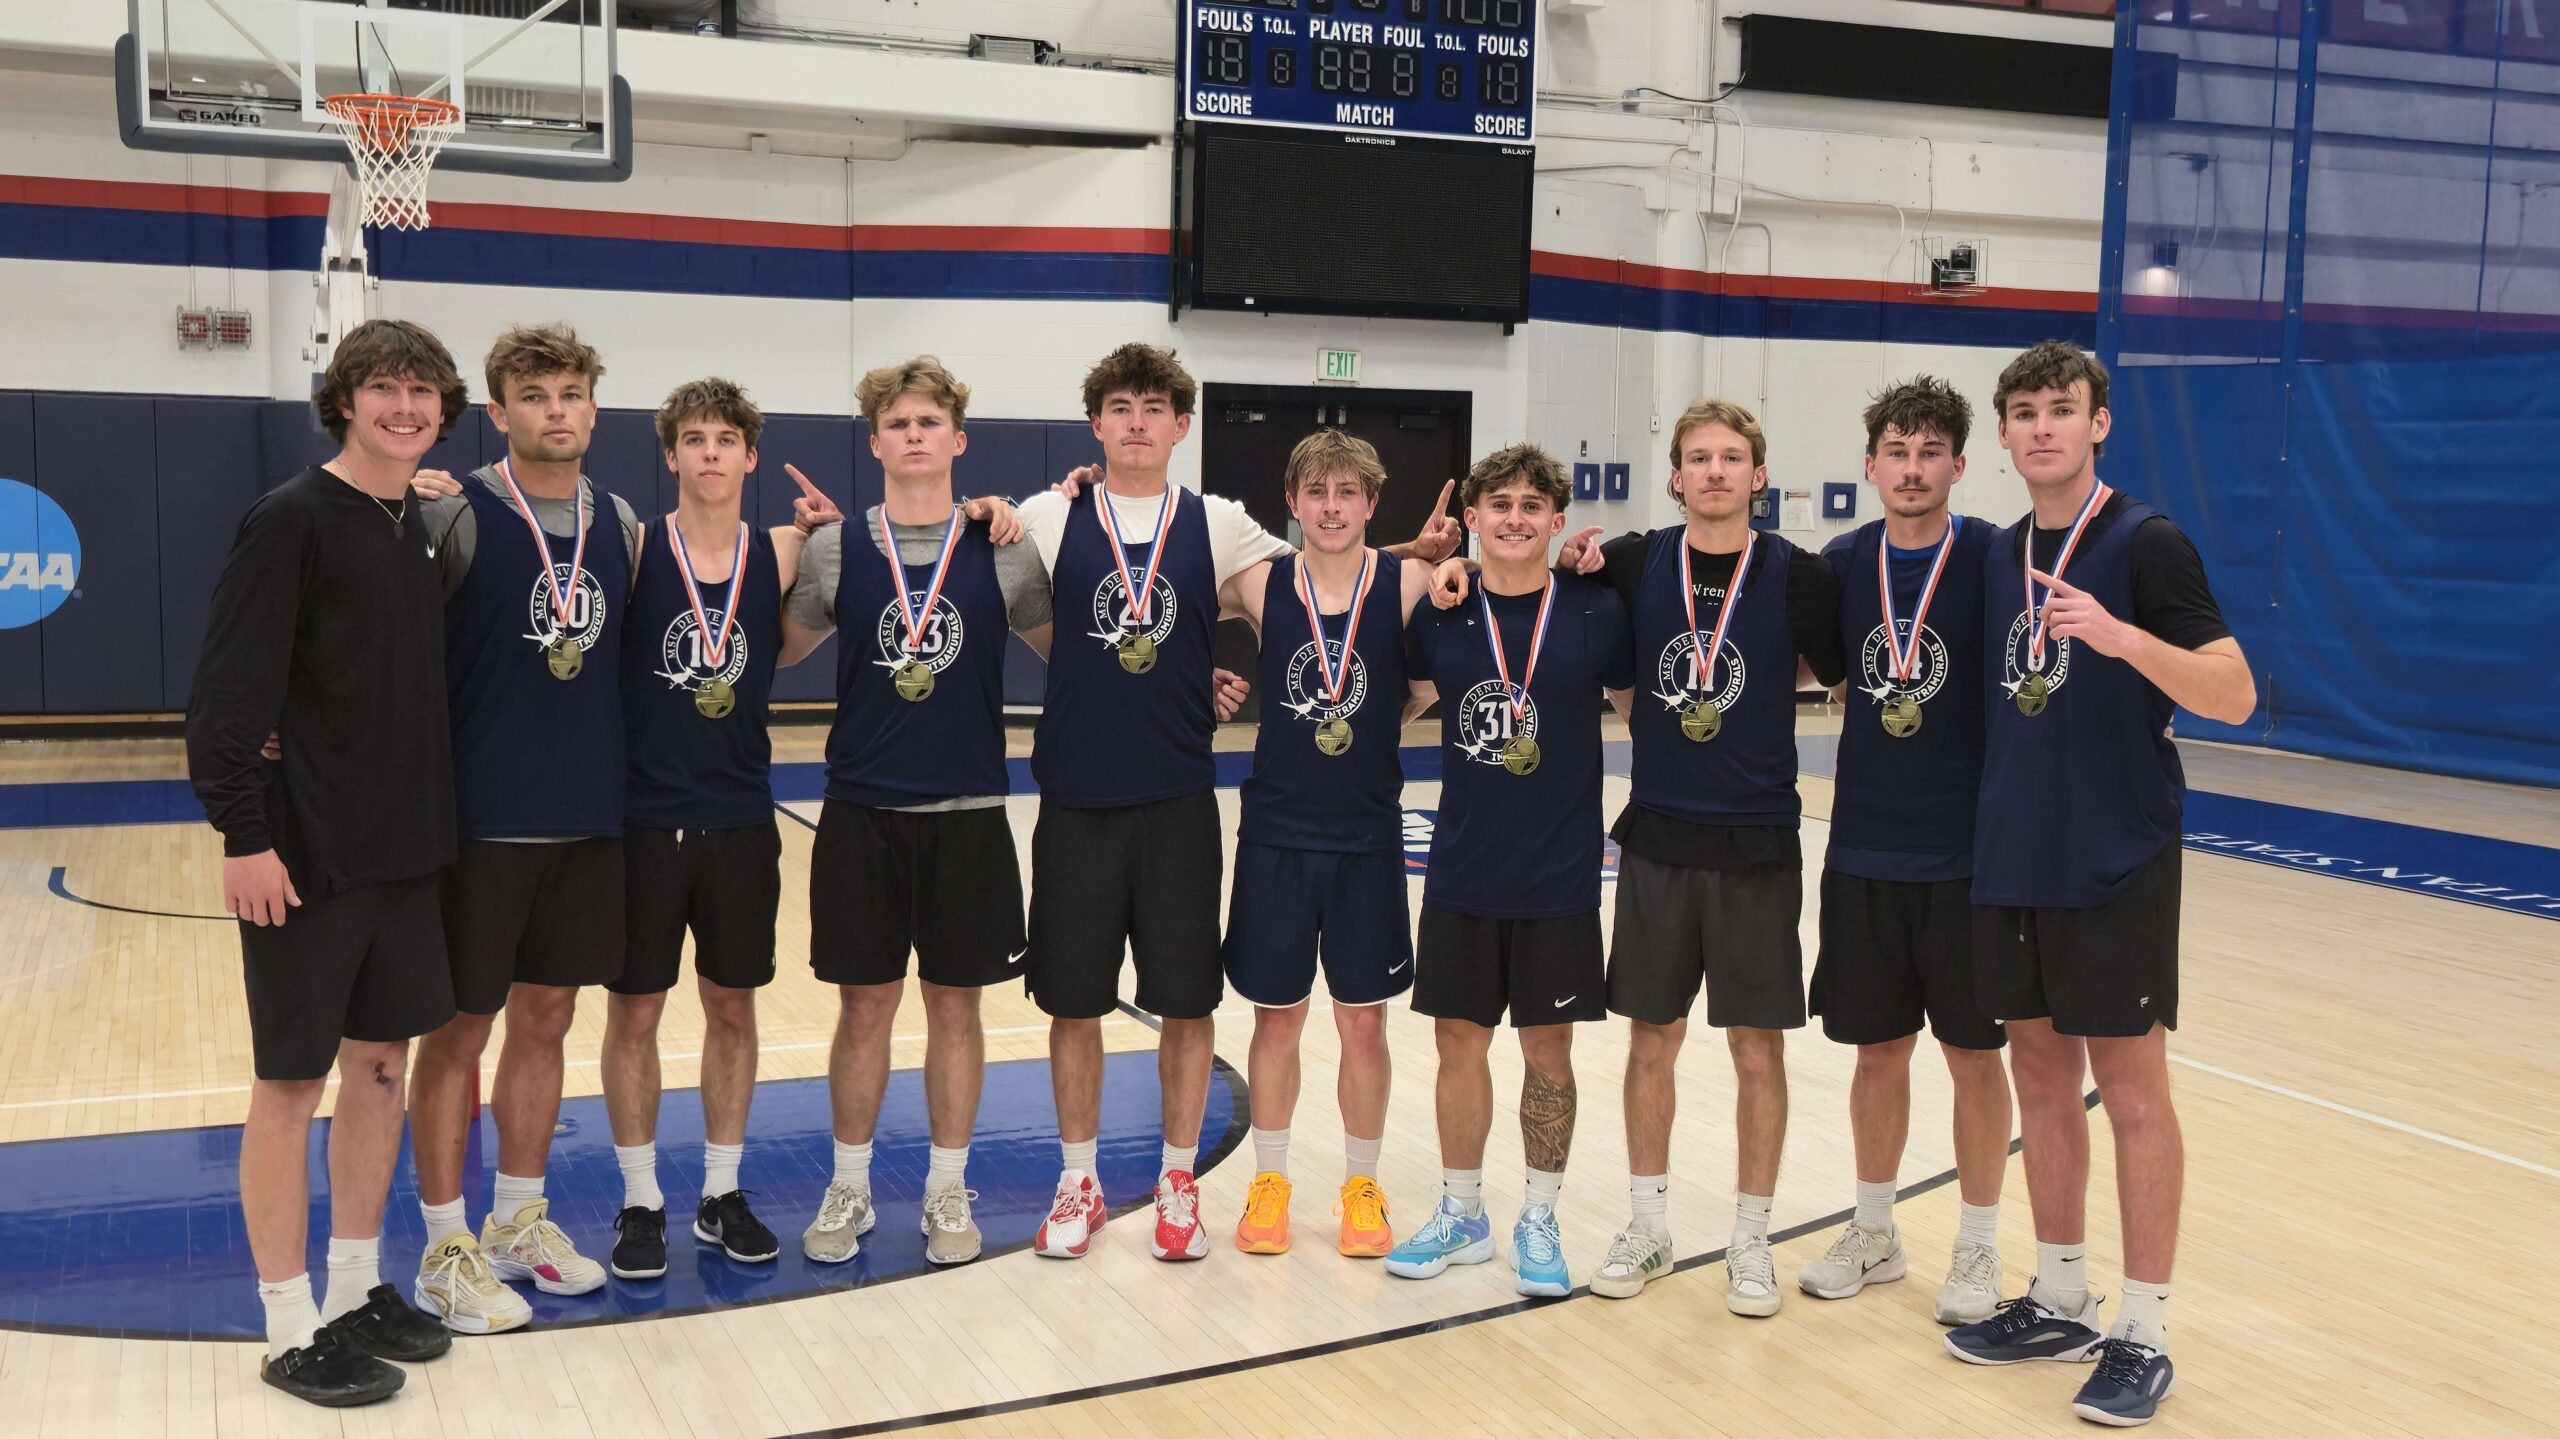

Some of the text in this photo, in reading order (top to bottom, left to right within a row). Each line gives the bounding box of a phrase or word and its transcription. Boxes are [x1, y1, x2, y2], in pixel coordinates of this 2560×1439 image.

[1197, 9, 1254, 33] FOULS
[1263, 16, 1297, 36] T.O.L.
[1309, 19, 1426, 48] PLAYER FOUL
[1434, 34, 1466, 52] T.O.L.
[1478, 34, 1529, 58] FOULS
[200, 111, 261, 124] GARED
[1196, 91, 1253, 116] SCORE
[1336, 102, 1394, 127] MATCH
[1475, 113, 1526, 137] SCORE
[1345, 136, 1396, 146] DAKTRONICS
[1501, 148, 1532, 156] GALAXY
[1326, 351, 1357, 378] EXIT
[534, 589, 546, 620] MSU
[575, 589, 604, 648] TRAMURALS
[1097, 591, 1108, 620] MSU
[1148, 588, 1174, 642] RAMURALS
[667, 632, 678, 659] MSU
[882, 619, 893, 647] MSU
[925, 612, 960, 671] NTRAMURALS
[1663, 651, 1674, 680] MSU
[1865, 645, 1875, 674] MSU
[1906, 642, 1945, 700] NTRAMURALS
[1290, 662, 1301, 690] MSU
[1714, 657, 1744, 711] RAMURALS
[1323, 662, 1364, 719] INTRAMURALS
[1462, 704, 1471, 731] MSU
[1478, 700, 1513, 741] 31
[2182, 832, 2364, 867] STATE
